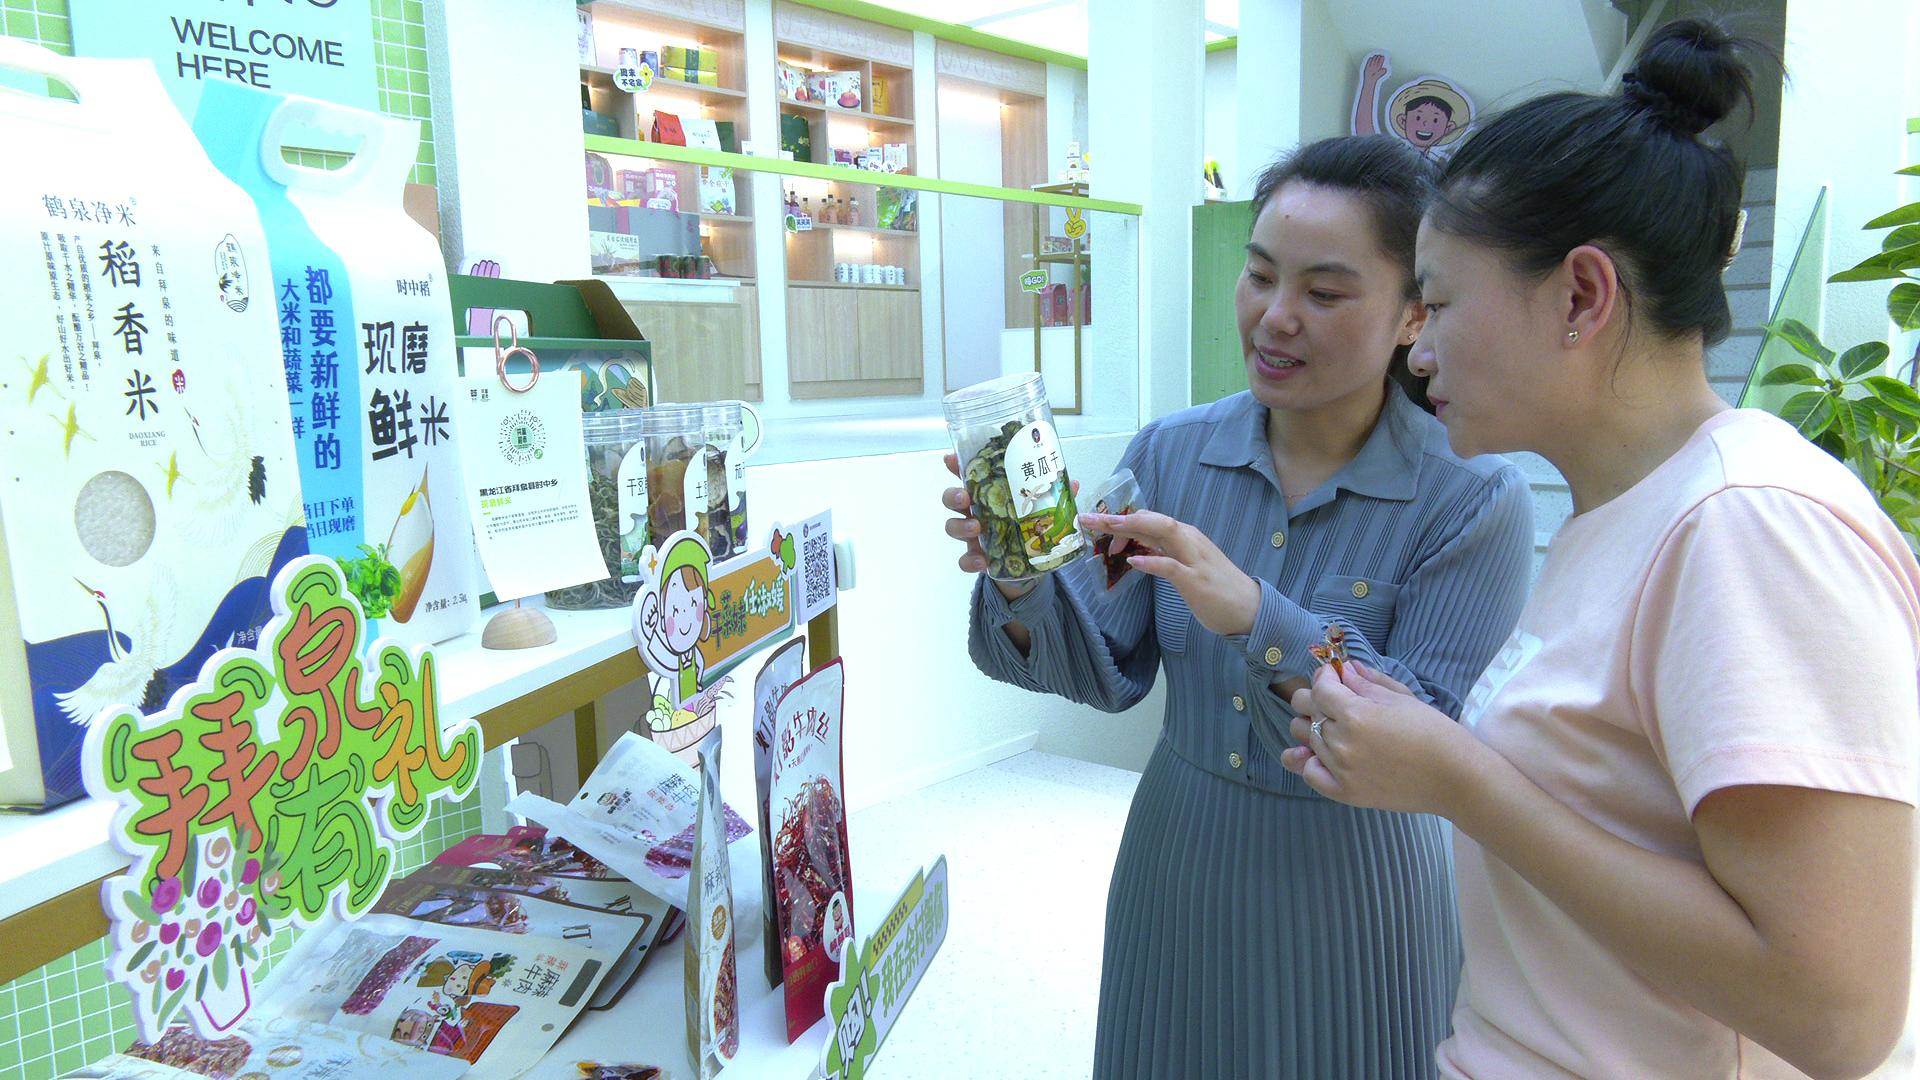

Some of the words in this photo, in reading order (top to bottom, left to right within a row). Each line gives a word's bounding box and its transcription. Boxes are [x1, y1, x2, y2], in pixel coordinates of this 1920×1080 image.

[170, 16, 345, 67] WELCOME
[176, 52, 271, 88] HERE
[41, 194, 137, 228] 鹤泉净米
[396, 279, 431, 297] 时中稻
[98, 240, 160, 421] 稻香米
[361, 320, 430, 375] 现磨
[281, 278, 306, 440] 大米和蔬菜一样
[304, 265, 342, 470] 都要新鲜的
[367, 387, 450, 462] 鲜米
[1020, 450, 1058, 482] 黄瓜干
[479, 478, 558, 497] 黑龙江省拜泉县时中乡
[626, 476, 648, 497] 干豆
[303, 496, 354, 520] 当日下单
[306, 515, 356, 540] 当日现磨
